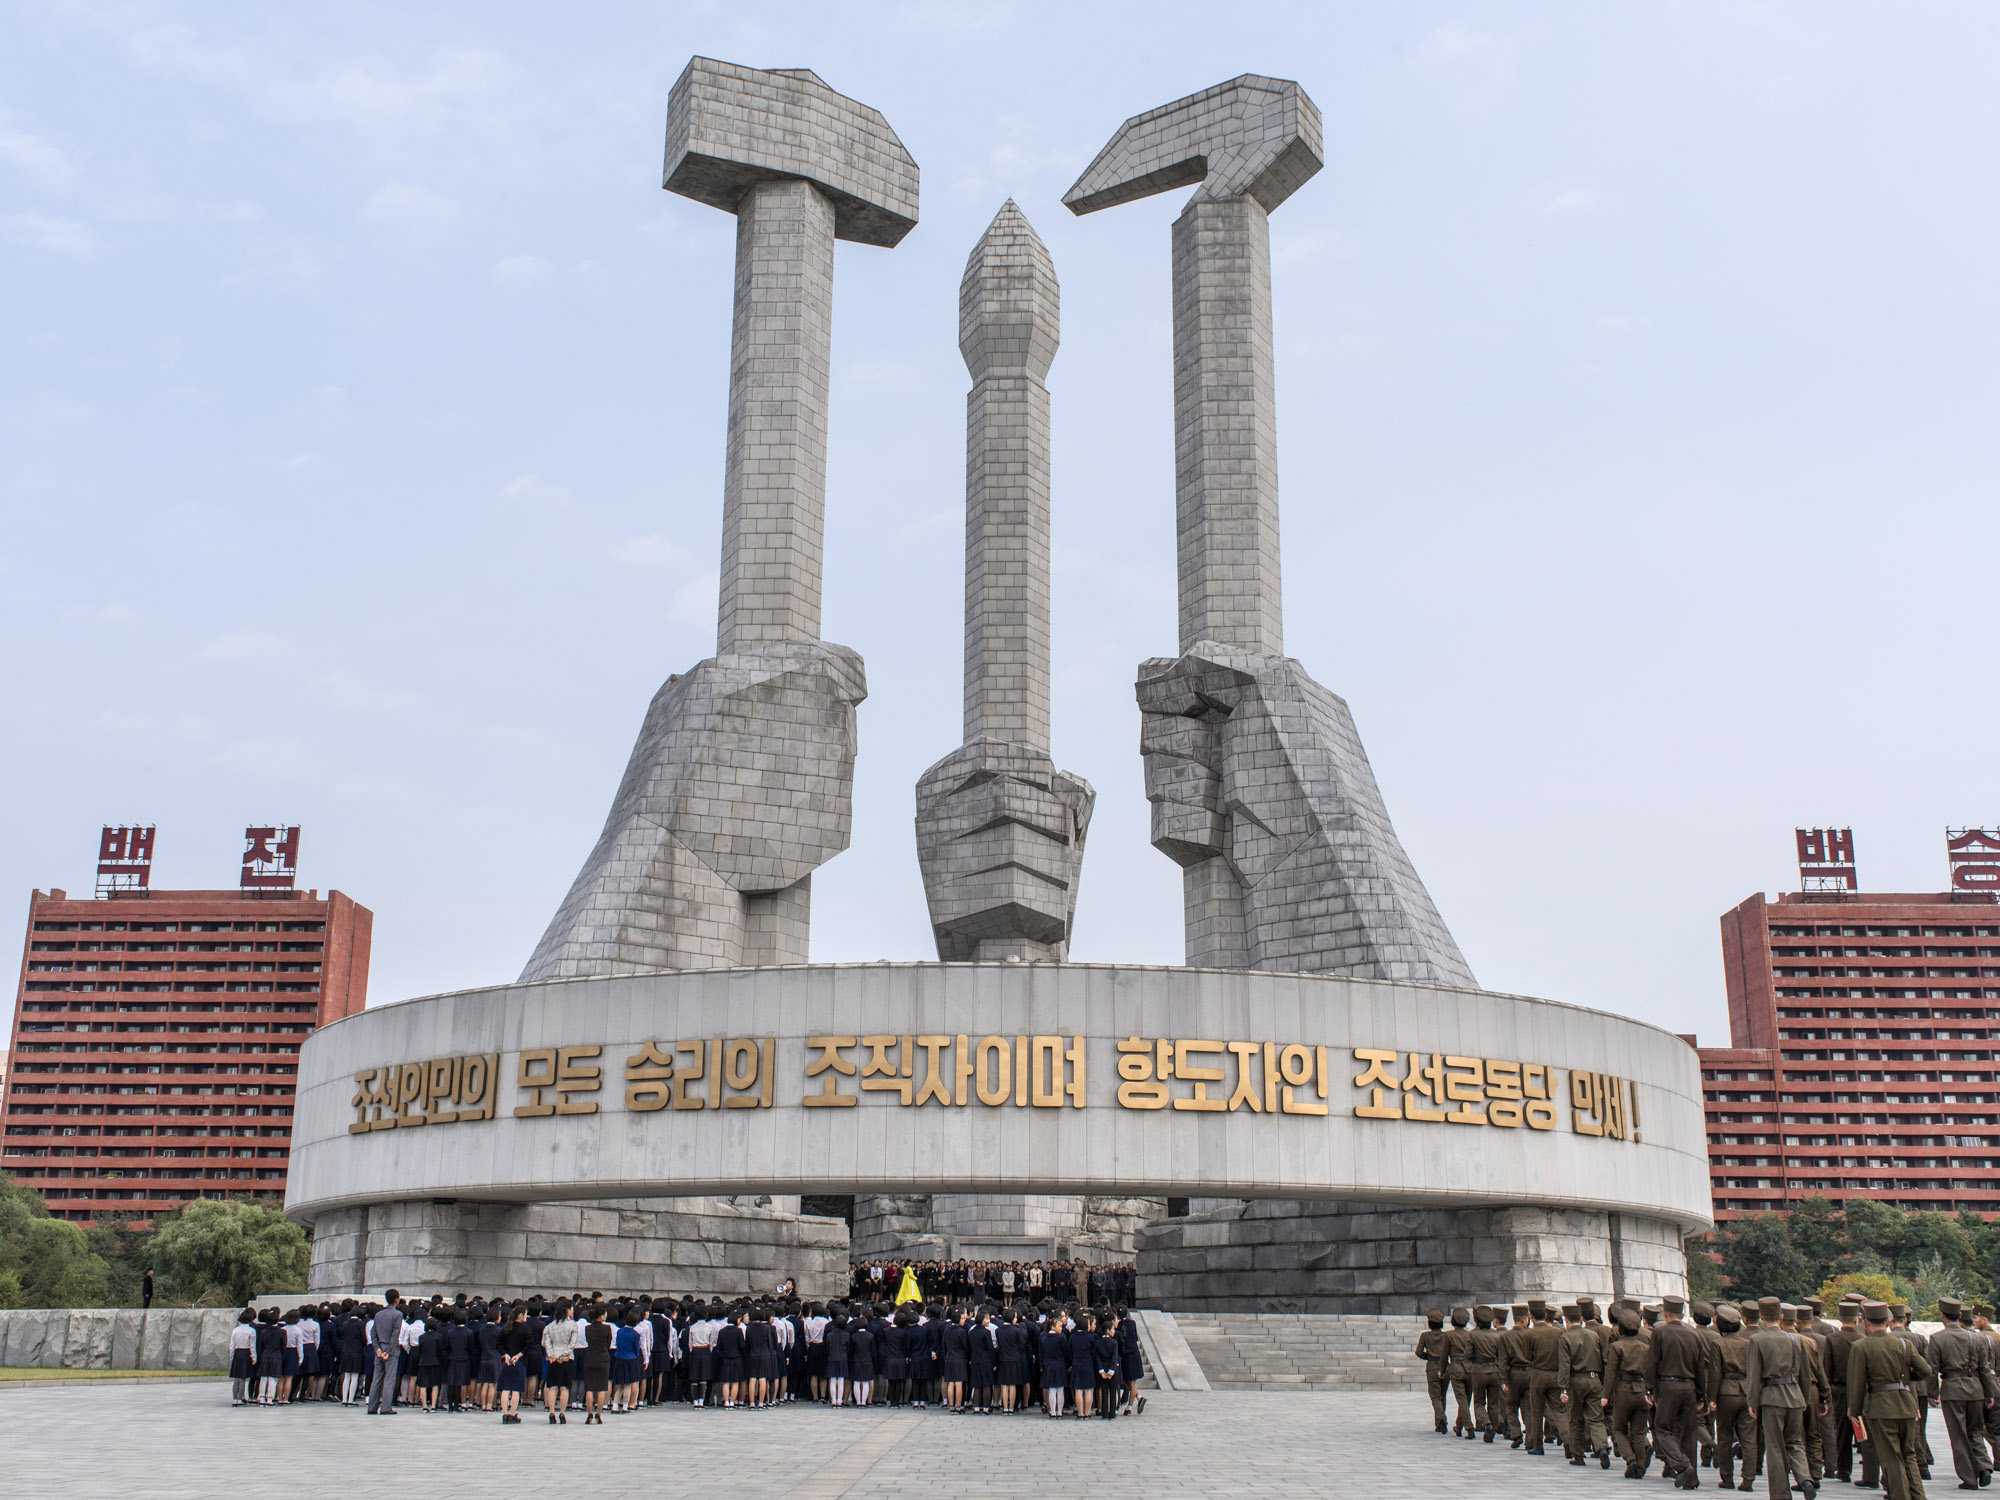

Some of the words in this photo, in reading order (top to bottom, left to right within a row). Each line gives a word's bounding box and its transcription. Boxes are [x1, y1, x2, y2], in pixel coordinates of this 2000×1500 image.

[348, 1053, 499, 1134] 조선인민의
[514, 1045, 601, 1118] 모든
[624, 1037, 775, 1111] 승리의
[803, 1034, 1085, 1108] 조직자이며
[1117, 1036, 1328, 1115] 향도자인
[1354, 1047, 1557, 1130] 조선로동당
[1569, 1069, 1642, 1142] 만세!
